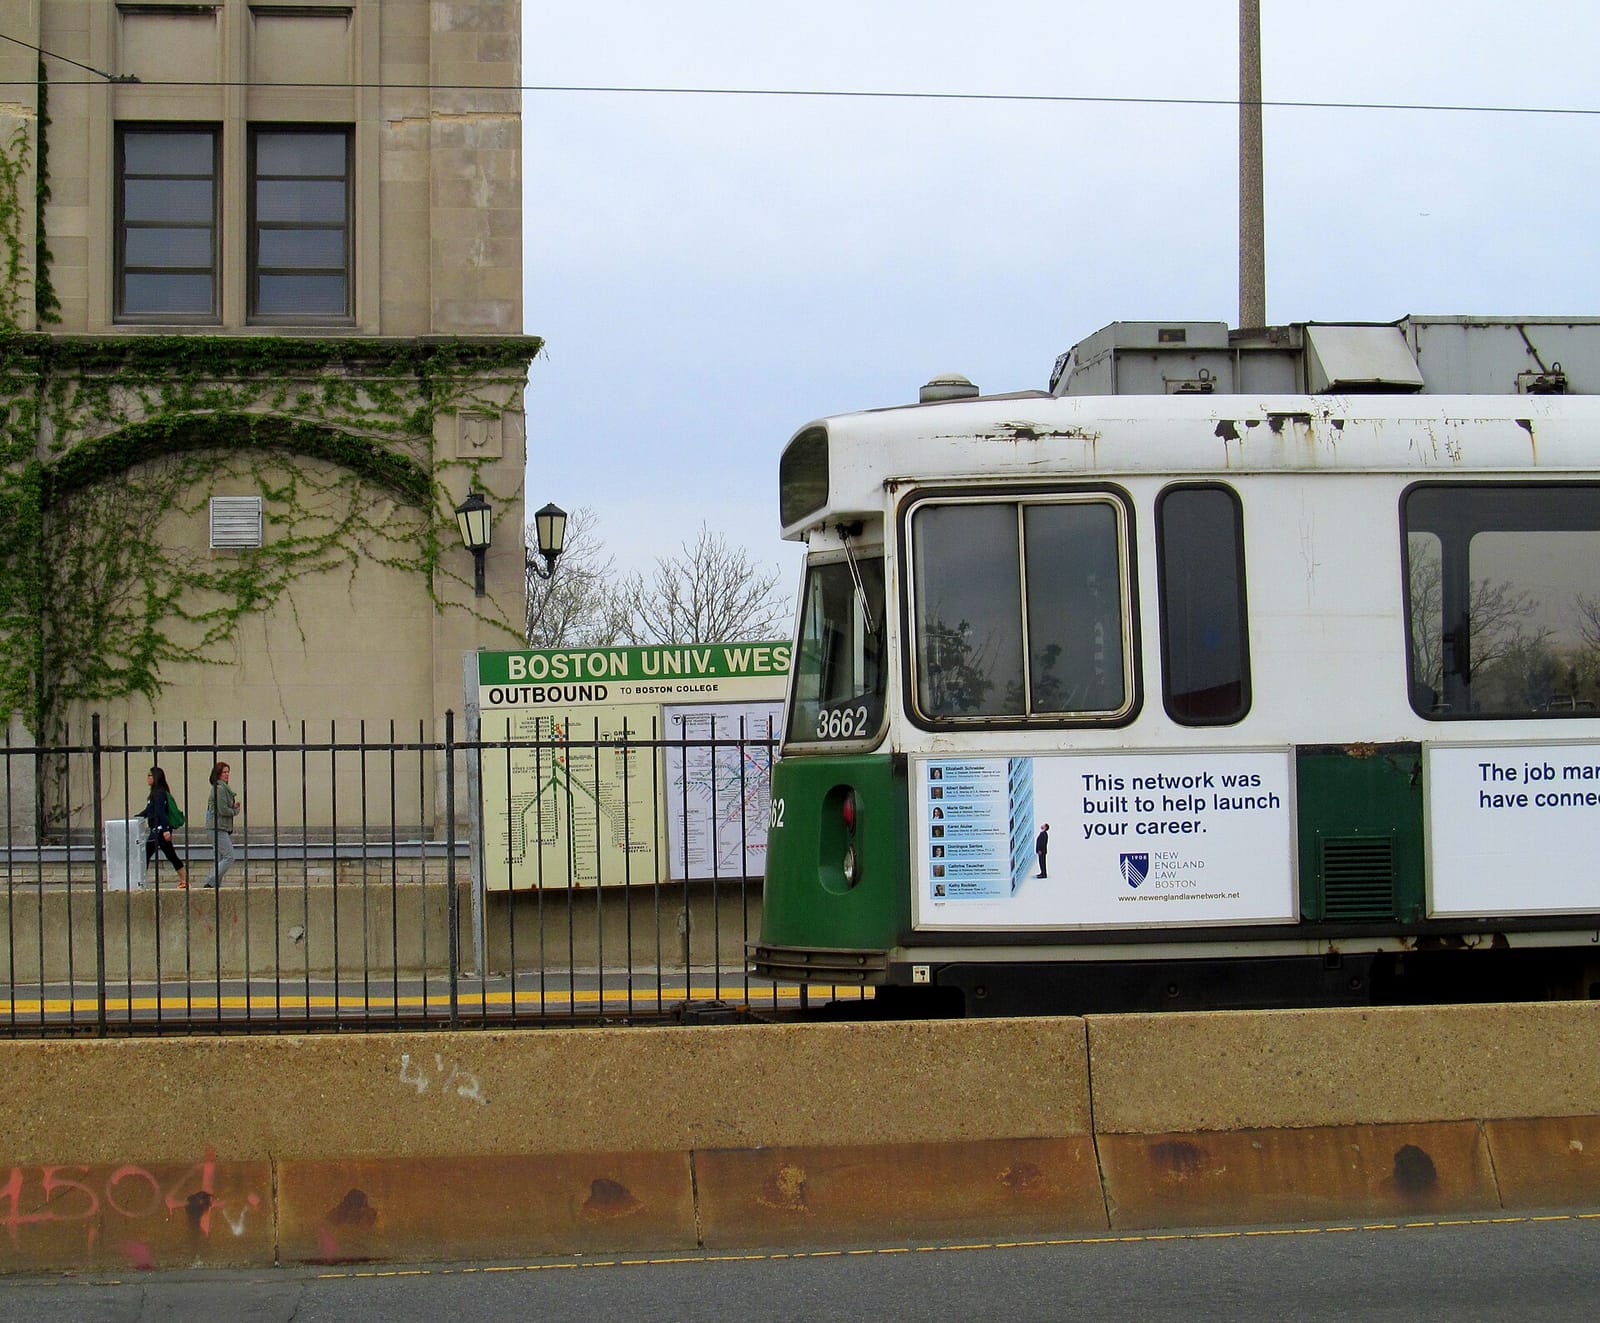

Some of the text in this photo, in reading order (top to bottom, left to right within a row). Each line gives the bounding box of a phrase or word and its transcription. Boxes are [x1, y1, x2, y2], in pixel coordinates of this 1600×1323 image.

[508, 646, 793, 680] BOSTON UNIV. WES
[488, 684, 608, 704] OUTBOUND
[620, 684, 719, 695] TO BOSTON COLLEGE
[816, 705, 869, 738] 3662
[1081, 771, 1261, 791] This network was
[1478, 763, 1517, 781] The
[1523, 762, 1556, 784] job
[1083, 792, 1280, 814] built to help launch
[1479, 790, 1600, 808] have conne
[769, 799, 785, 828] 62
[1083, 820, 1207, 839] your career.
[1154, 851, 1179, 860] NEW
[1154, 860, 1205, 870] ENGLAND
[1154, 871, 1177, 880] LAW
[1155, 880, 1197, 889] BOSTON
[1118, 891, 1240, 902] www.newenglandlawnetwork.net
